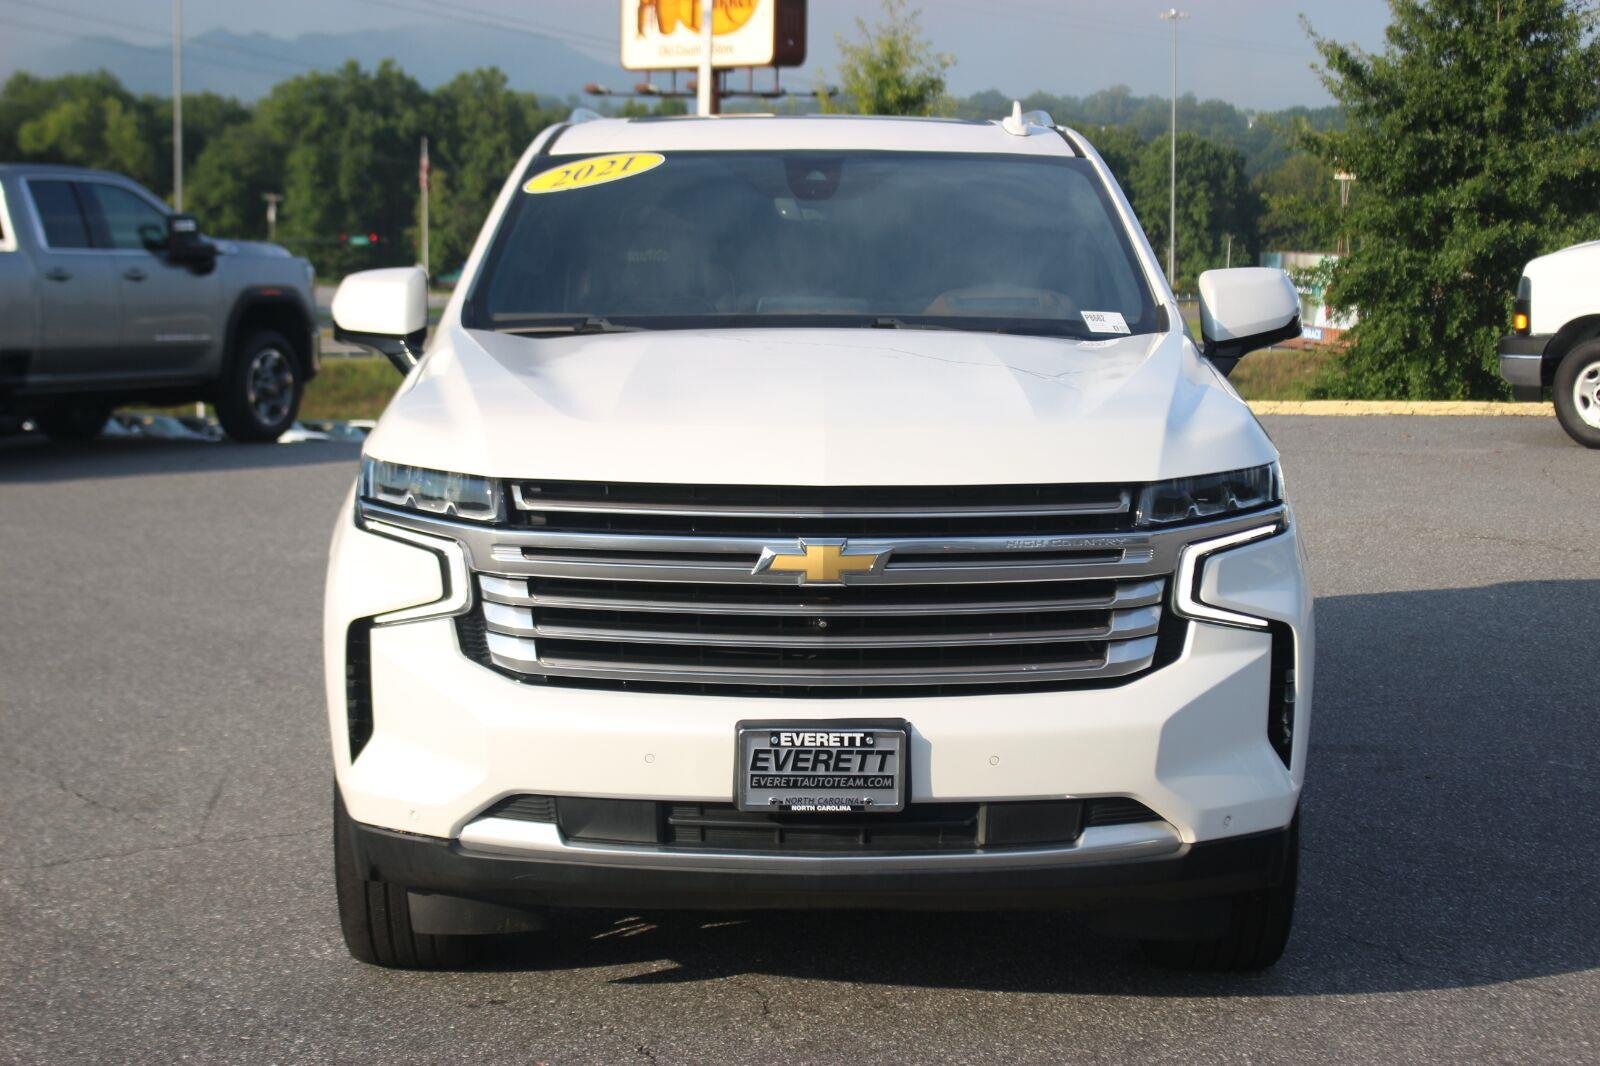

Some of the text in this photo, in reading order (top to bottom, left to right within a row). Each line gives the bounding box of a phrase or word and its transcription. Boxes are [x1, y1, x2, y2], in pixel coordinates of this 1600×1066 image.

[550, 157, 636, 188] 2021
[1007, 538, 1128, 549] HIGH COUNTRY
[780, 732, 864, 747] EVERETT
[750, 749, 895, 772] EVERETT
[752, 776, 892, 787] EVERETTAUTOTEAM.COM
[785, 797, 860, 805] NORTH CAROLINA
